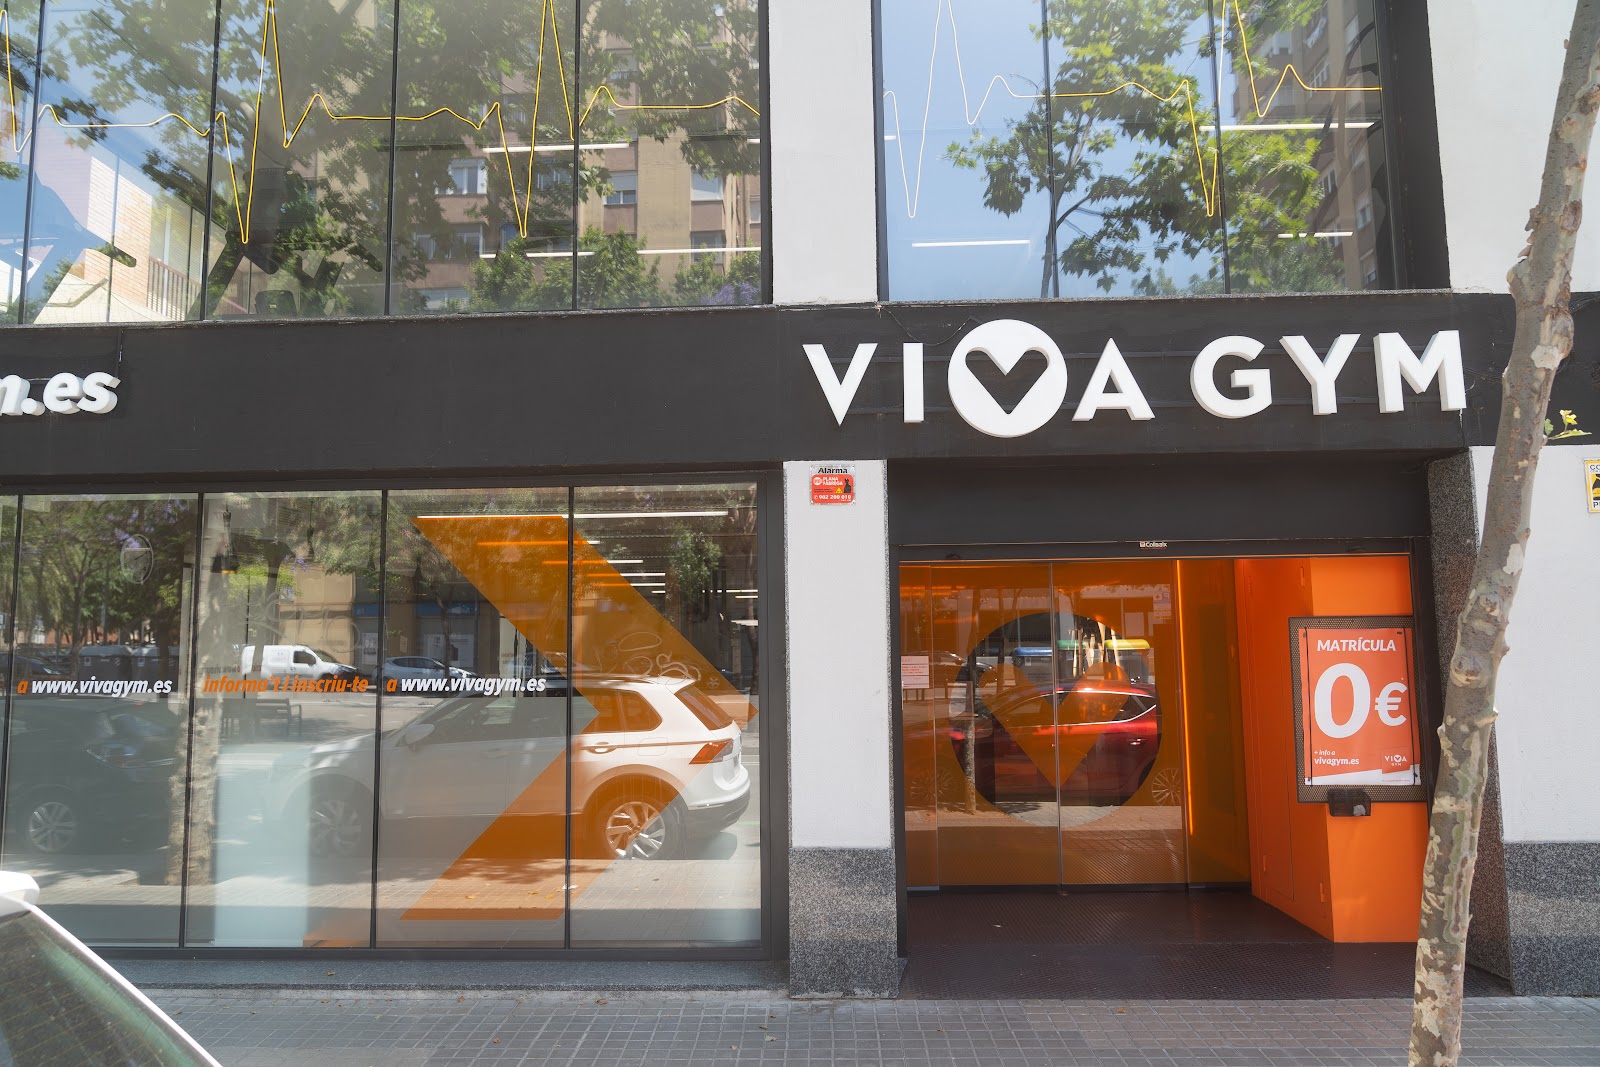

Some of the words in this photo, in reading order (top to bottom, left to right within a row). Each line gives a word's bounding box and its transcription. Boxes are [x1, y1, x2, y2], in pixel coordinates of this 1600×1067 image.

[1190, 330, 1466, 419] GYM
[1317, 637, 1396, 652] MATRÍCULA
[17, 680, 28, 694] a
[31, 675, 173, 698] www.vivagym.es
[291, 674, 369, 693] inscriu-te
[386, 680, 397, 693] a
[401, 673, 546, 696] www.vivagym.es
[1314, 756, 1360, 766] vivagym.es
